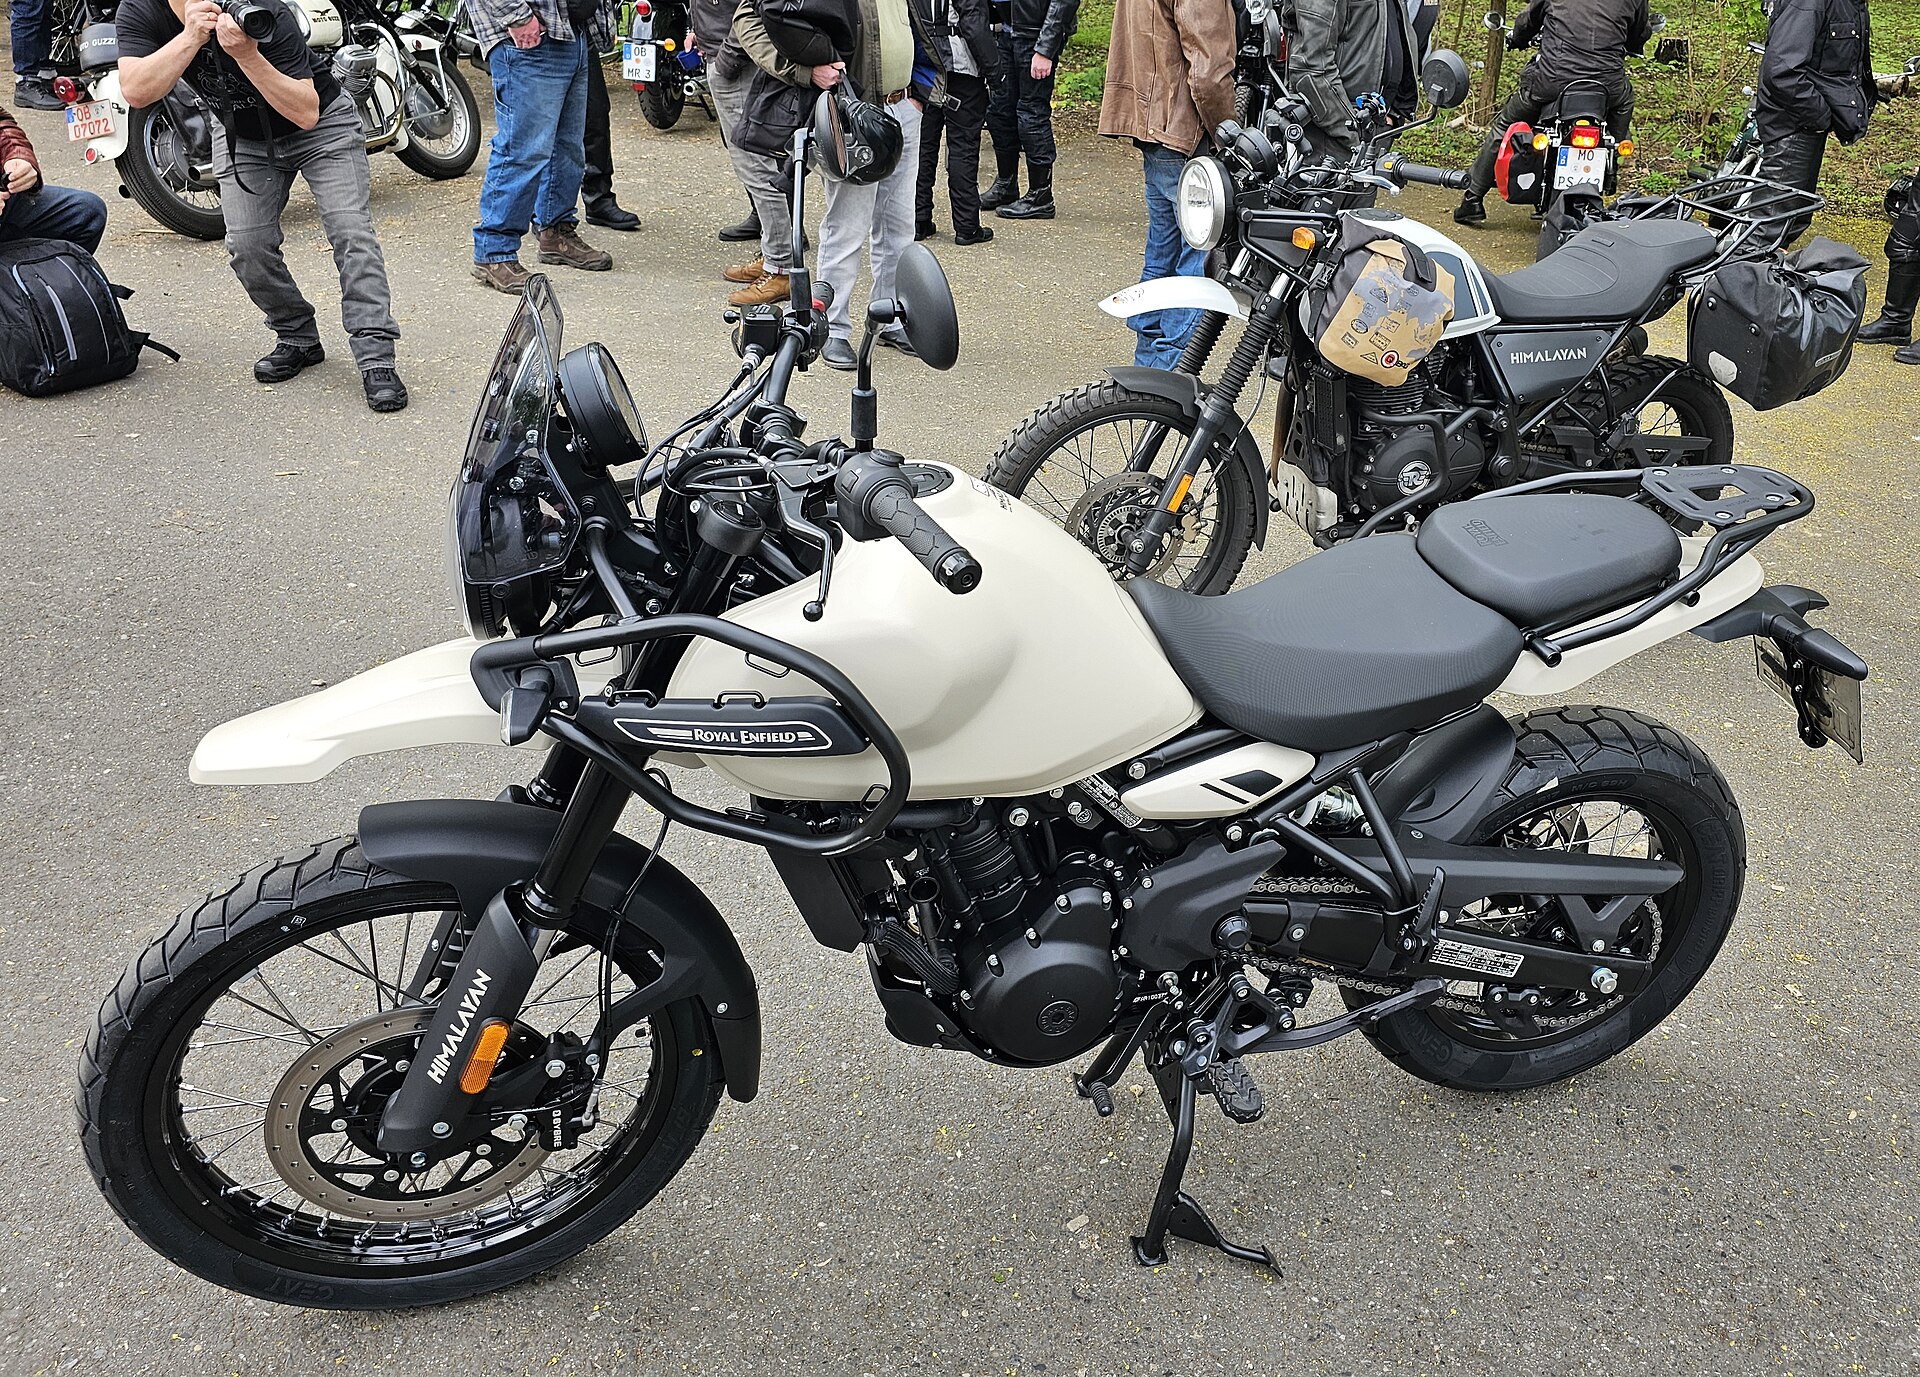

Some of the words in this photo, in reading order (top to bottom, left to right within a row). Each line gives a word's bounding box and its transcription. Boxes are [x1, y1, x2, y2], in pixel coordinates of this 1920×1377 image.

[92, 38, 116, 46] GUZZI
[634, 46, 647, 57] OB
[627, 68, 641, 78] MR
[645, 69, 651, 79] 3
[76, 105, 91, 121] OB
[74, 118, 110, 138] 07072
[1578, 149, 1594, 161] MO
[1510, 347, 1587, 364] HIMALAYAN
[693, 728, 739, 742] ROYAL
[740, 730, 796, 744] ENFIELD
[427, 968, 492, 1084] HIMALAYAN
[553, 1119, 562, 1147] BYBRE
